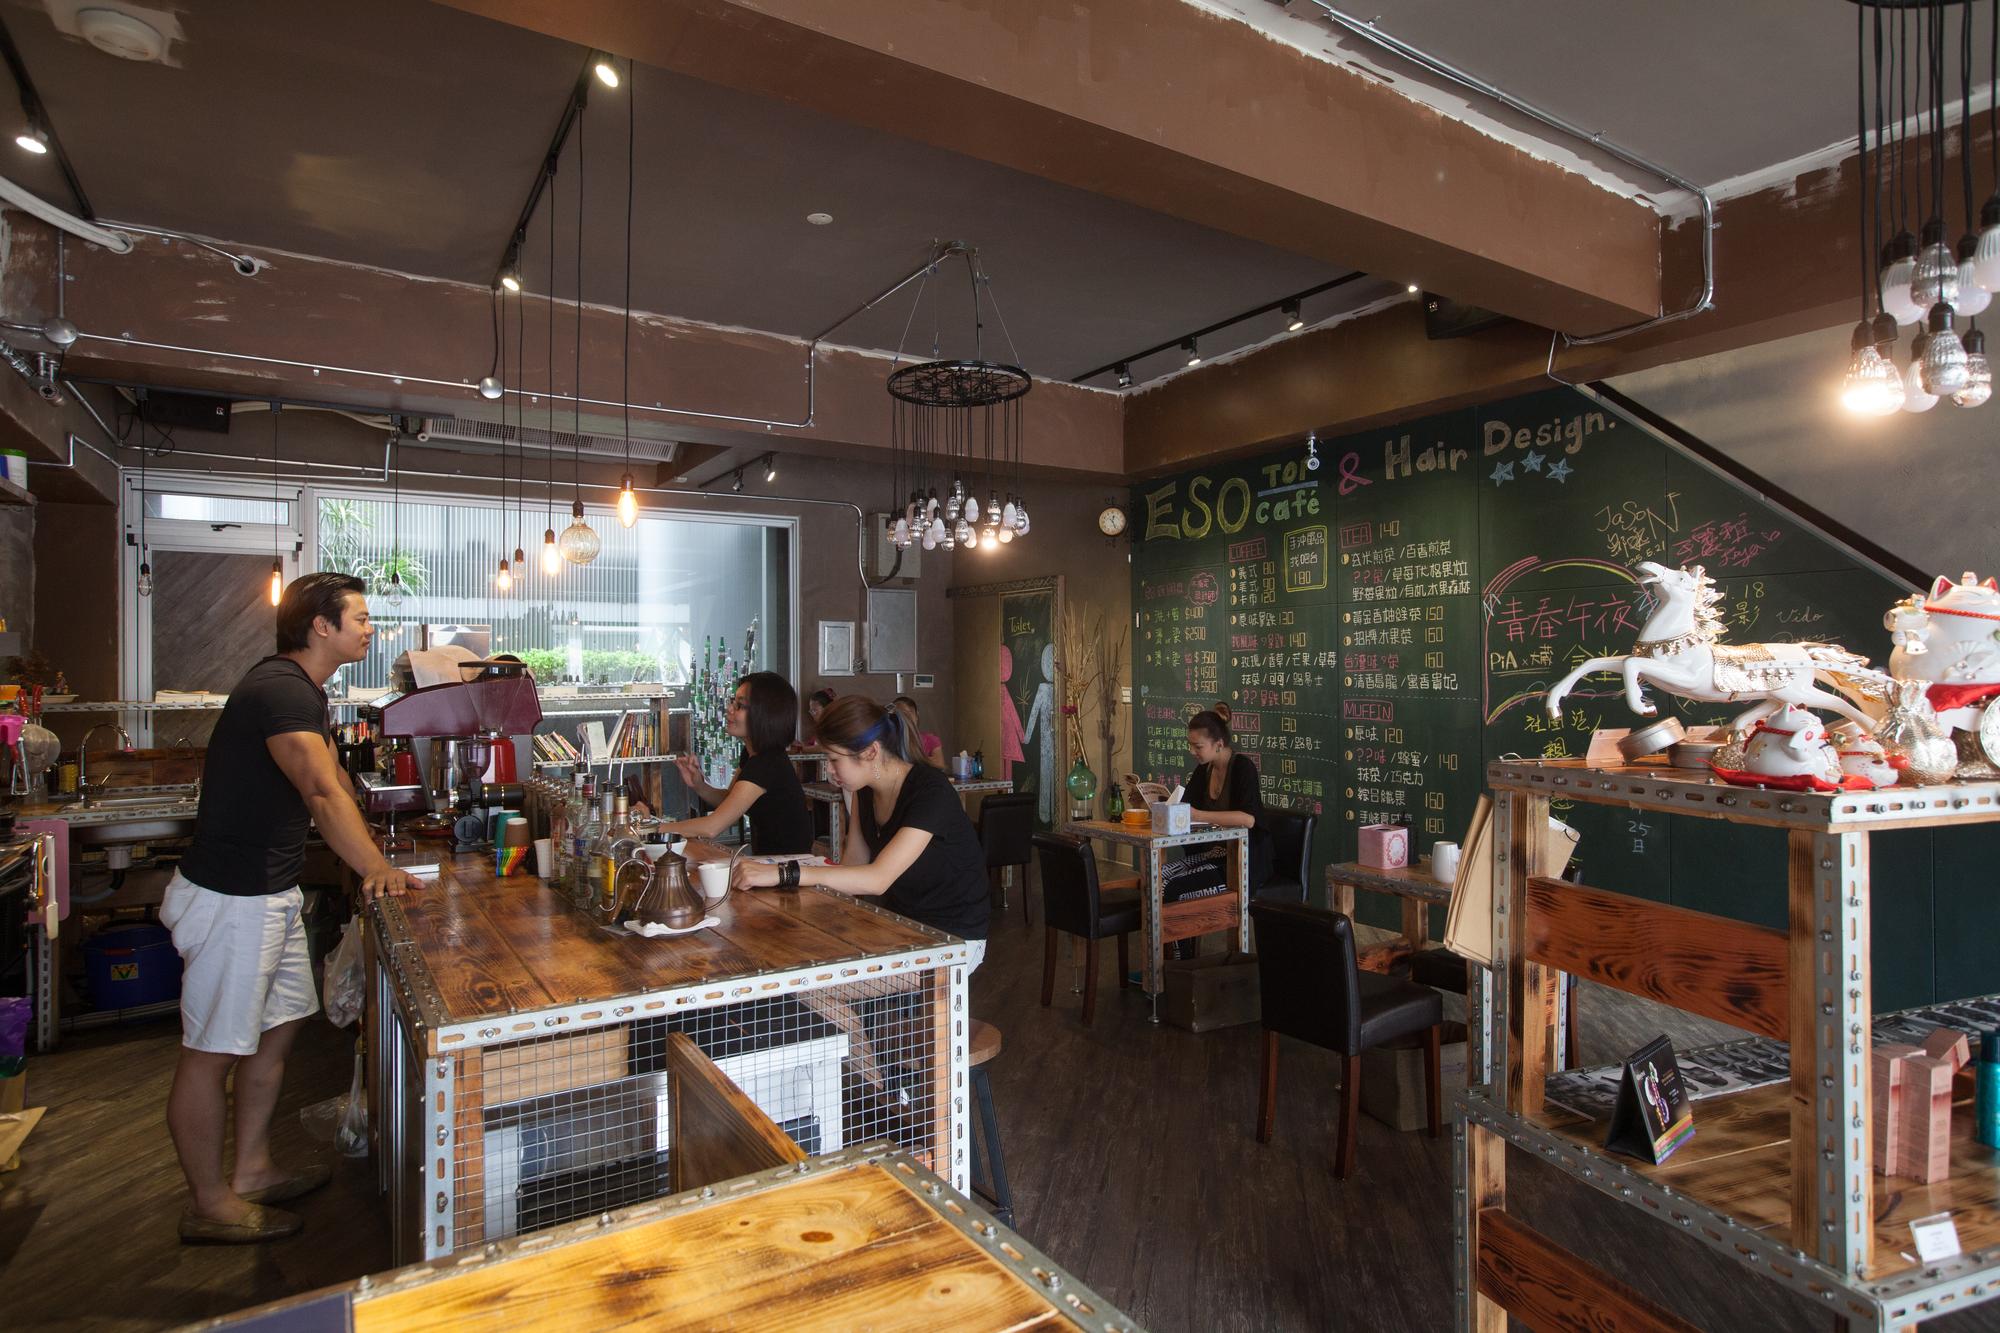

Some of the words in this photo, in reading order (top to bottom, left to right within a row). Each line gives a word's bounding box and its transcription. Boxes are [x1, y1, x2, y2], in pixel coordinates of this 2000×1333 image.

[1339, 452, 1374, 496] &
[1385, 435, 1468, 480] Hair
[1145, 476, 1250, 541] ESO
[1256, 490, 1321, 524] café
[1380, 520, 1400, 539] 140
[1425, 606, 1444, 621] 150
[1496, 595, 1639, 643] 青春午夜
[1008, 616, 1031, 632] Toilet
[1289, 632, 1306, 648] 140
[1424, 627, 1444, 643] 160
[1425, 652, 1444, 668] 160
[1345, 702, 1392, 719] MUFFIN
[1232, 714, 1258, 729] MILK
[1384, 728, 1403, 744] 120
[1439, 753, 1459, 770] 140
[1425, 792, 1445, 810] 160
[1425, 816, 1445, 834] 180
[1628, 820, 1654, 837] 25
